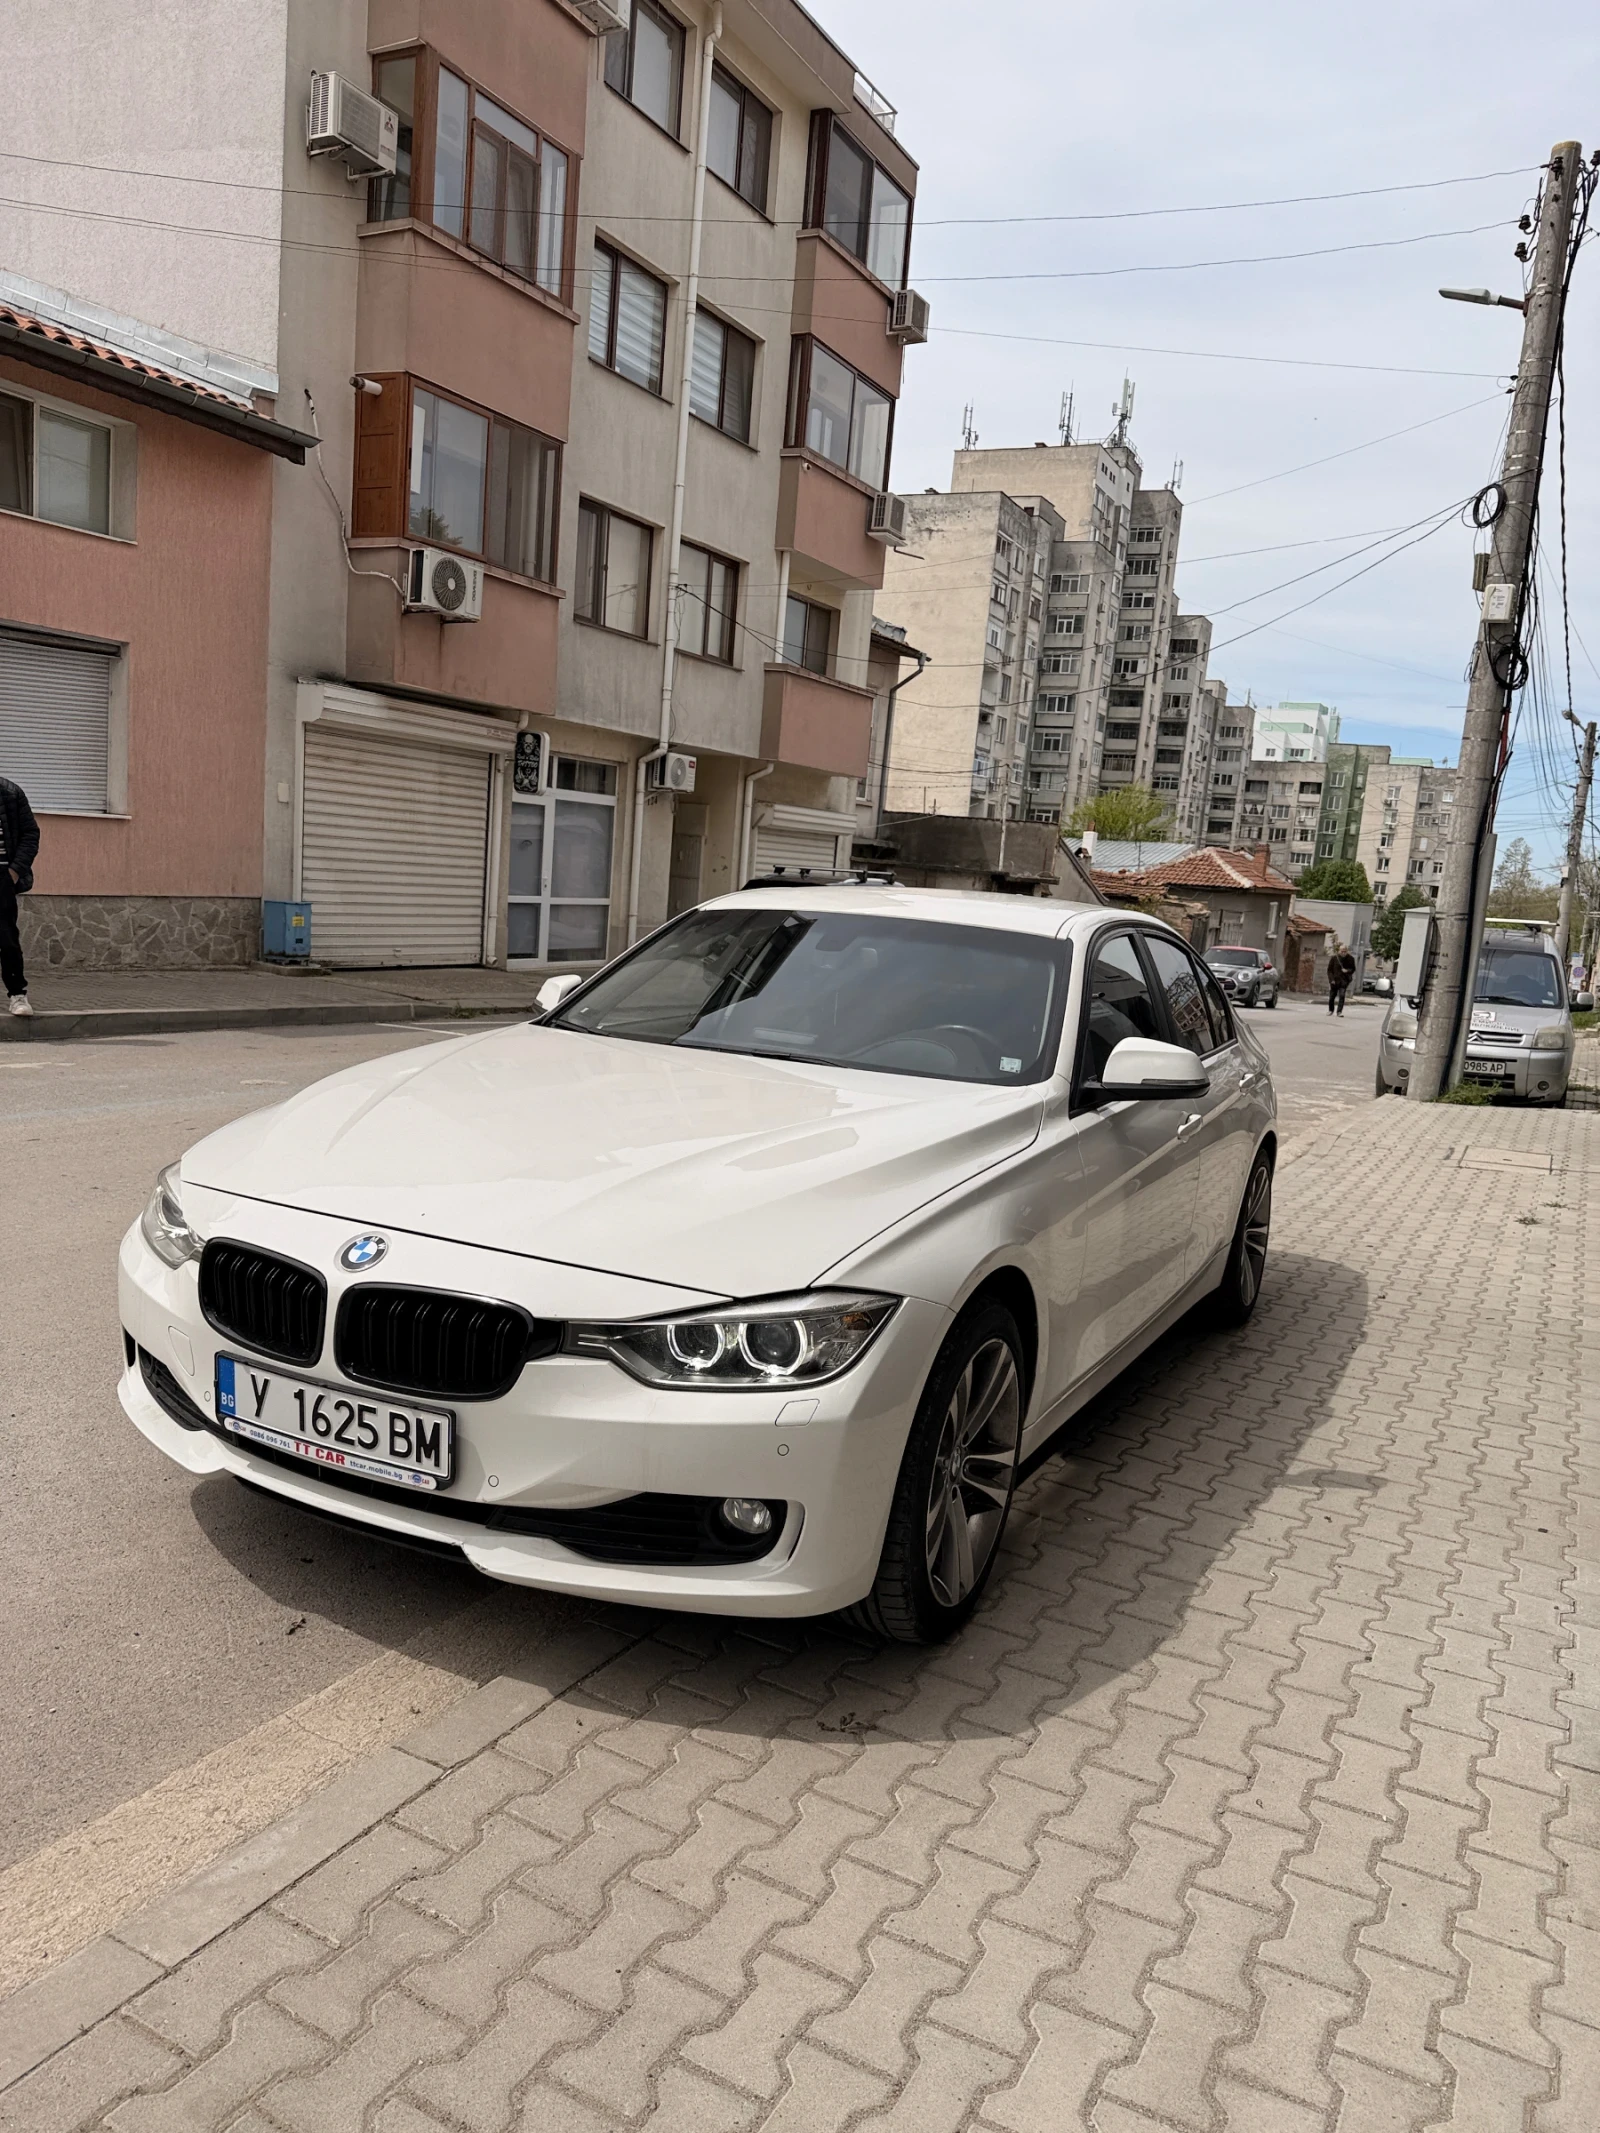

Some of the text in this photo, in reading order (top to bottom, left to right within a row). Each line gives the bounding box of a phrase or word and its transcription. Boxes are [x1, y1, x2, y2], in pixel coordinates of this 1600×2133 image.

[1463, 1061, 1503, 1073] 0985 AP
[221, 1392, 235, 1407] BG
[294, 1388, 379, 1450] 1625
[389, 1411, 441, 1468] BM
[294, 1440, 345, 1465] TT CAR
[350, 1460, 403, 1480] ttcar.mobile.bg
